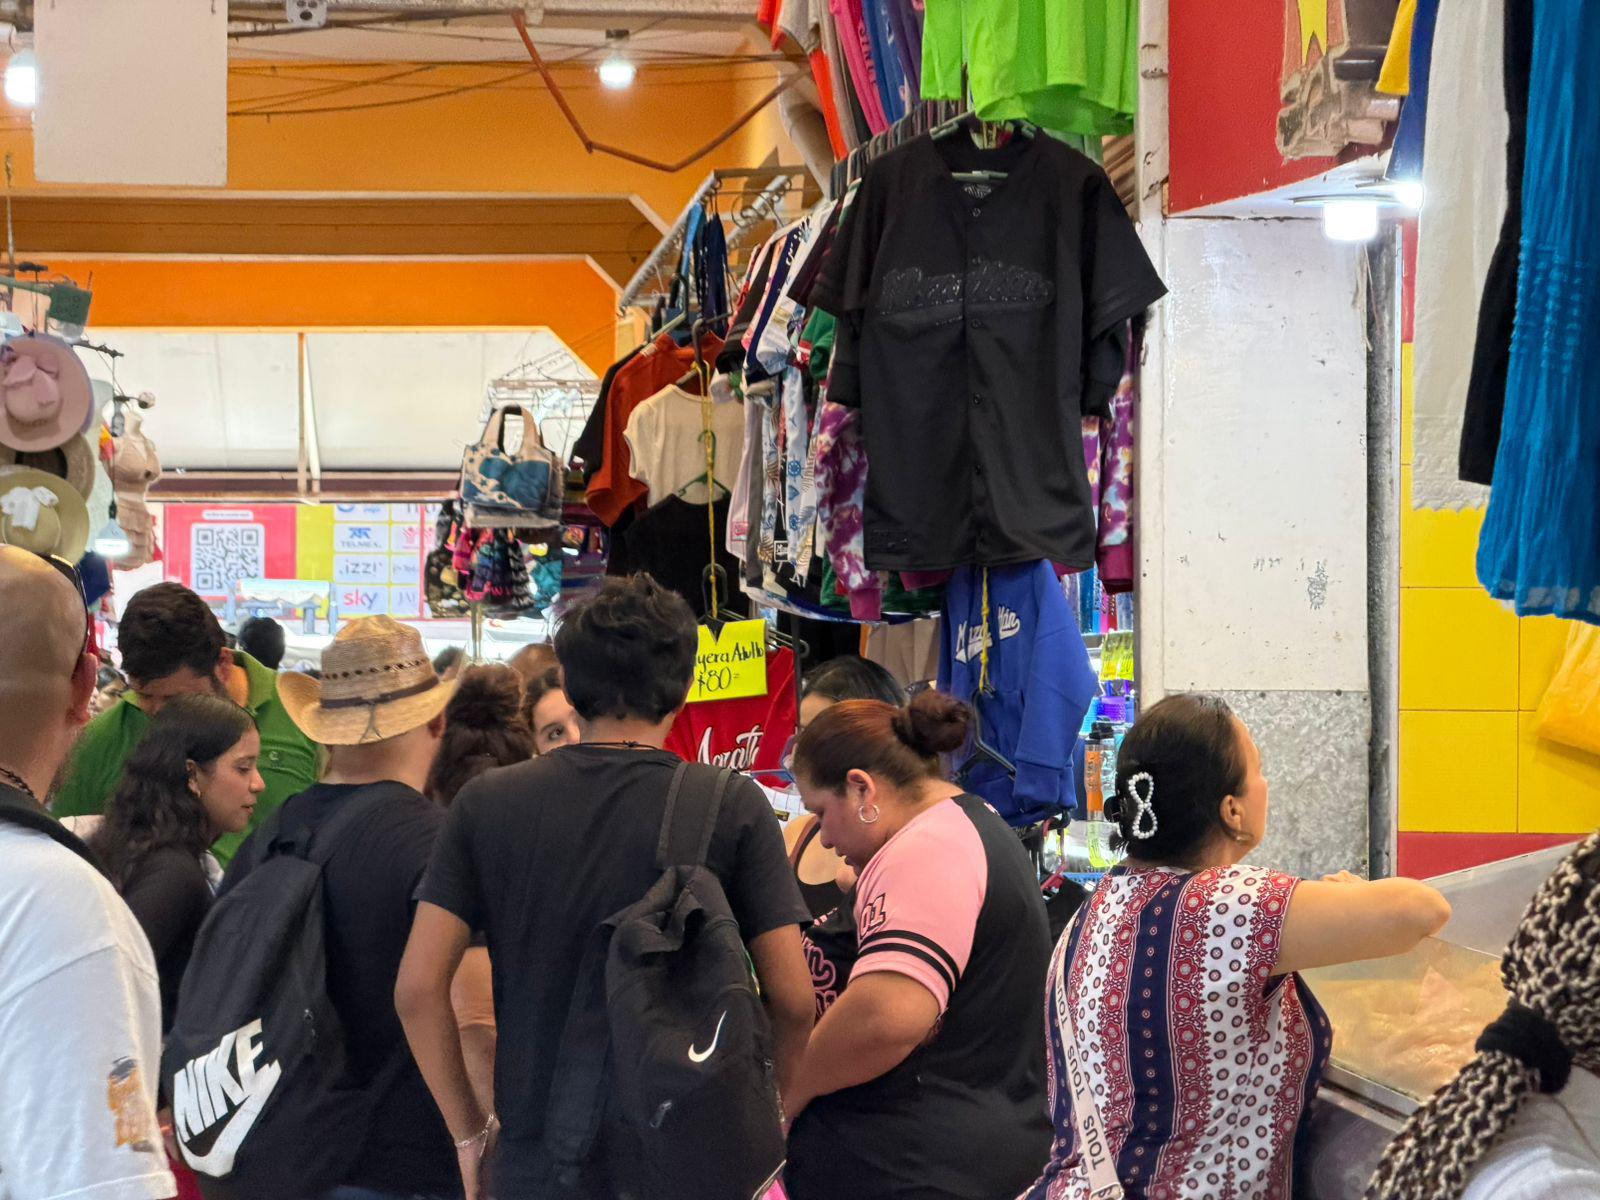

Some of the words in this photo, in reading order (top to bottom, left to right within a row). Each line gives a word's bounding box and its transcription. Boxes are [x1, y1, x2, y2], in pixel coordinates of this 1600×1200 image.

[343, 588, 377, 609] sky
[694, 652, 729, 673] yera
[173, 1018, 270, 1143] NIKE
[1067, 1045, 1085, 1101] TOUS
[1083, 1114, 1106, 1170] TOUS
